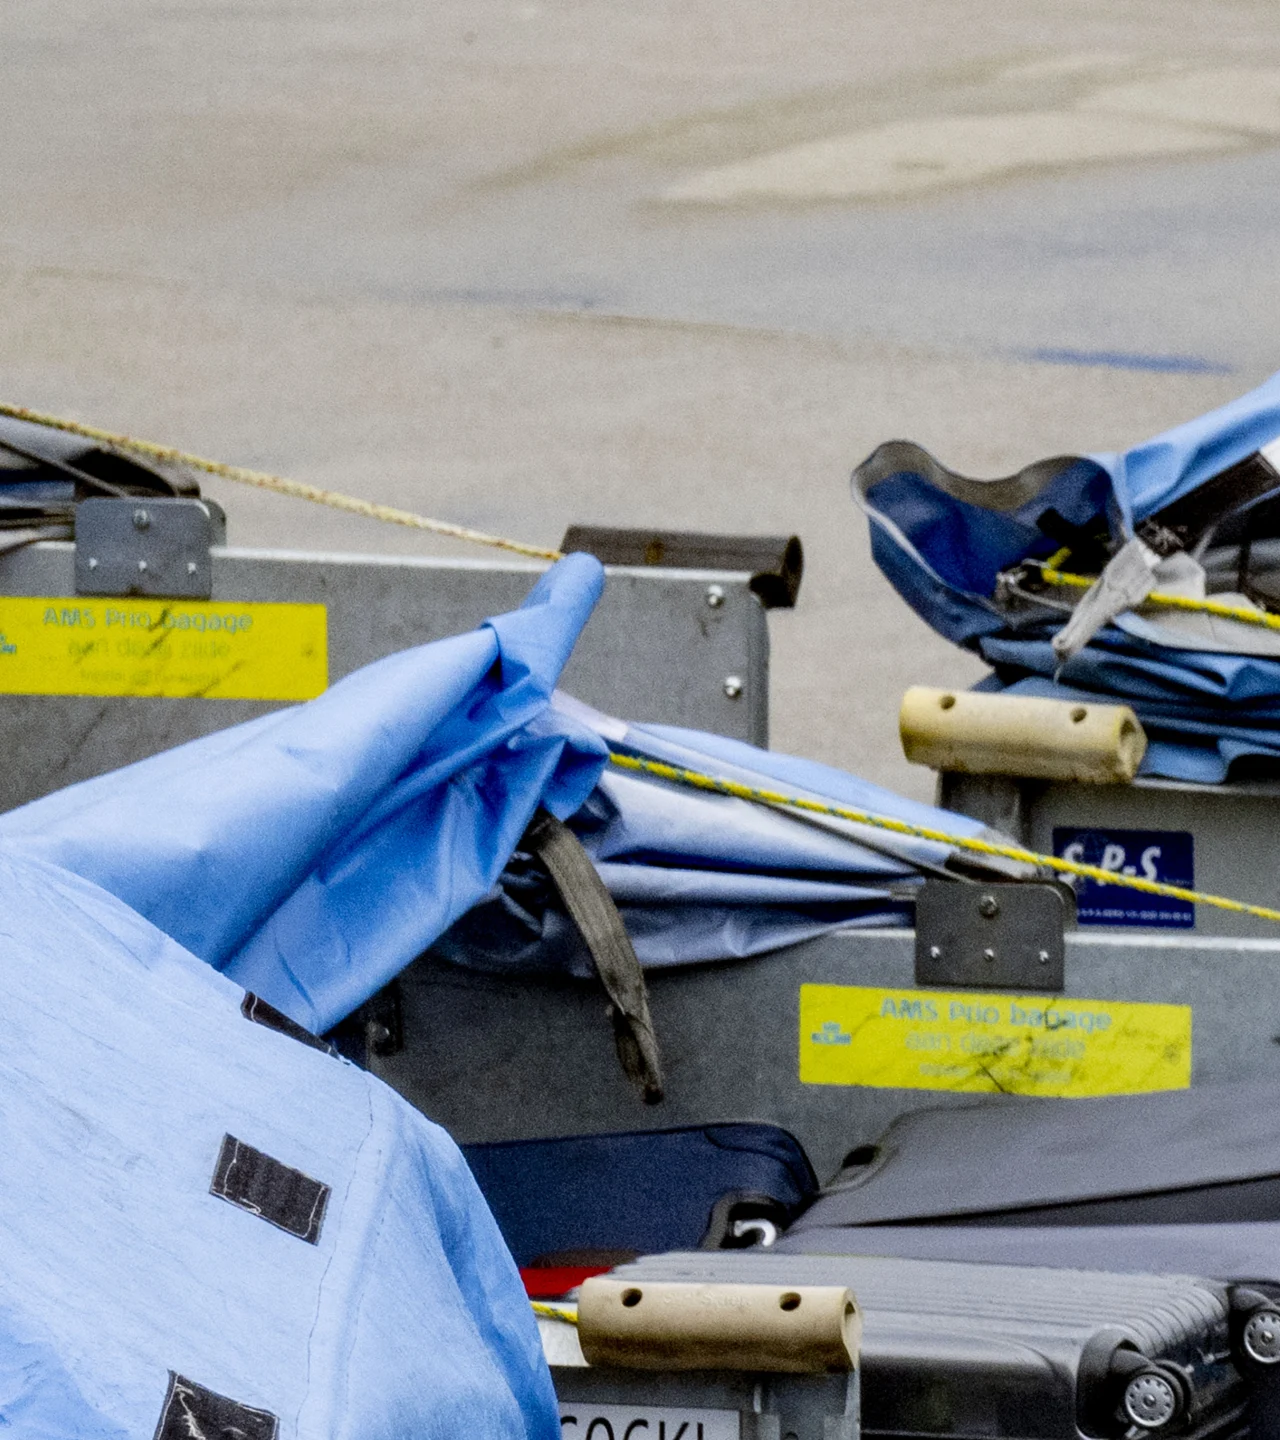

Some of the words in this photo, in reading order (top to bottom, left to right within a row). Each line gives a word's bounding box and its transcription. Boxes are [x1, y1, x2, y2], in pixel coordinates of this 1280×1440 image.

[43, 607, 96, 628] AMS
[1058, 842, 1162, 887] SP-S
[880, 997, 938, 1022] AMS
[950, 1000, 999, 1025] Prio
